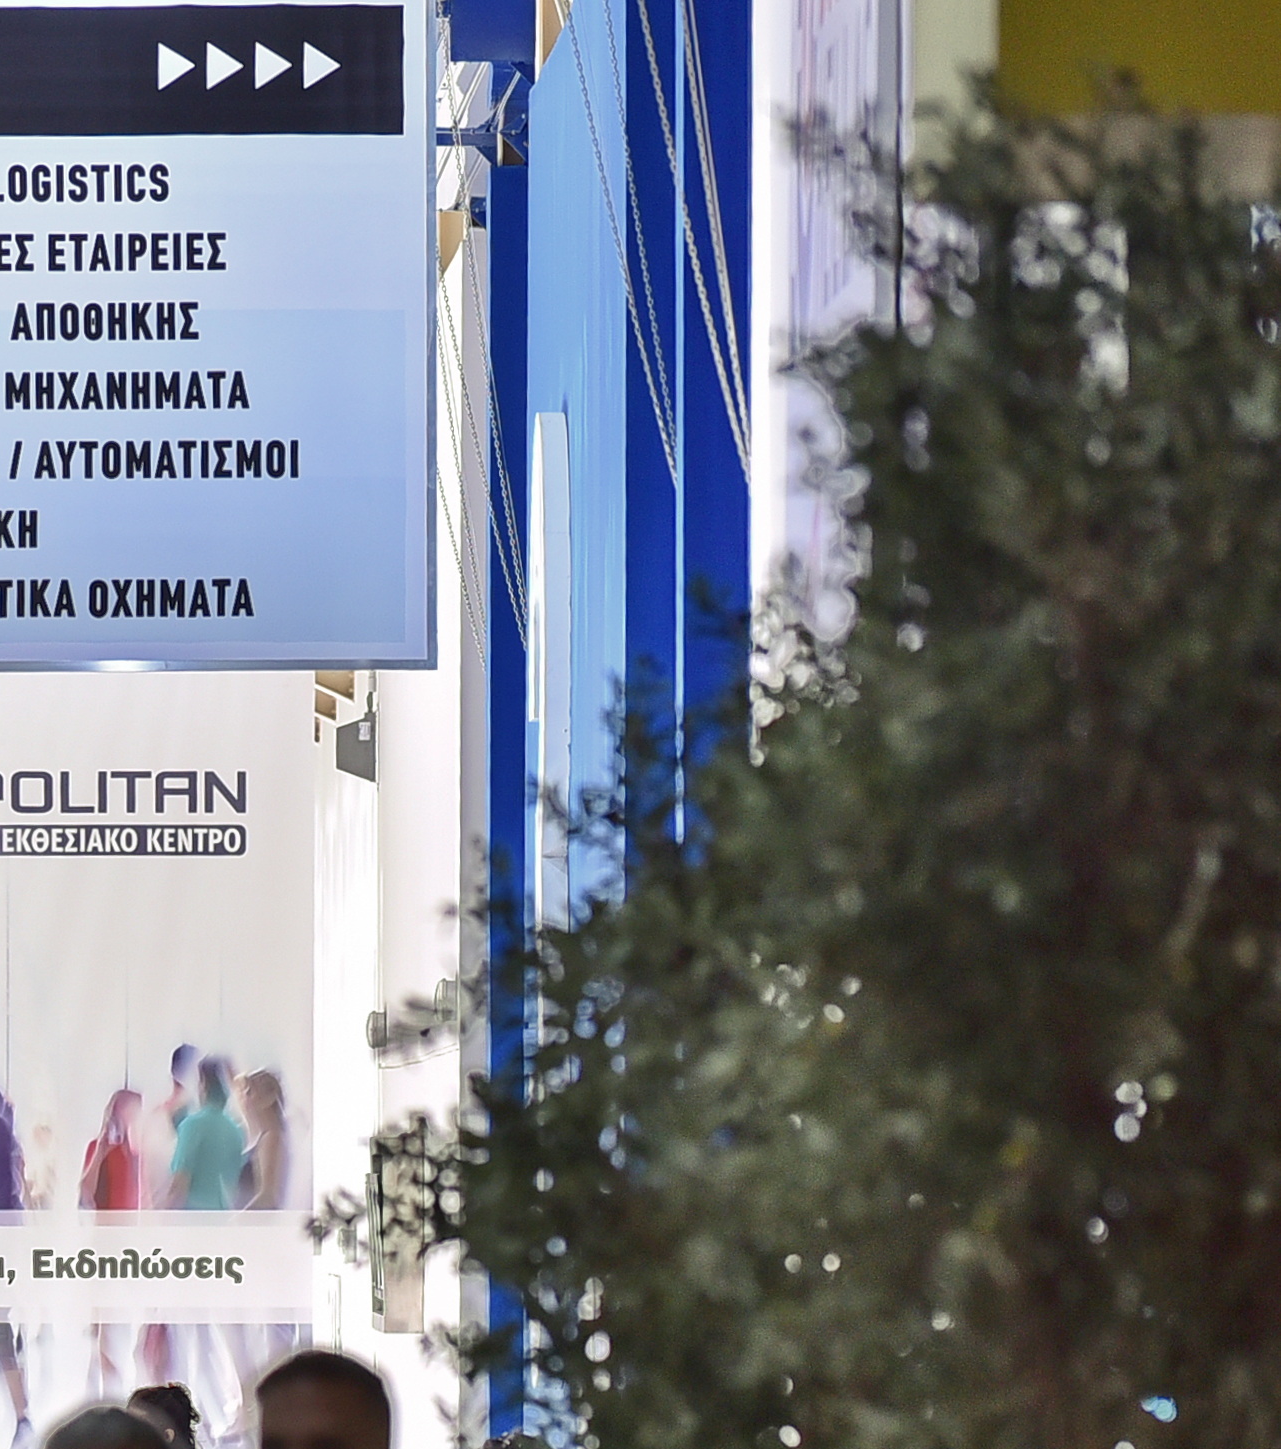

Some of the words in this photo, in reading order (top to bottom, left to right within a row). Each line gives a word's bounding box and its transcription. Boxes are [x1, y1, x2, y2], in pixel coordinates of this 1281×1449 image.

[47, 232, 227, 271] ΕΤΑΙΡΕΙΕΣ
[10, 302, 199, 341] ΑΠΟΘΗΚΗΣ
[5, 371, 250, 409] ΜΗΧΑΝΗΜΑΤΑ
[9, 440, 23, 479] /
[34, 440, 299, 478] ΑΥΤΟΜΑΤΙΣΜΟΙ
[88, 578, 254, 617] ΟΧΗΜΑΤΑ
[2, 828, 138, 853] ΕΚΘΕΣΙΑΚΟ
[146, 828, 241, 853] ΚΕΝΤΡΟ
[33, 1248, 244, 1284] Εκδηλώσεις
